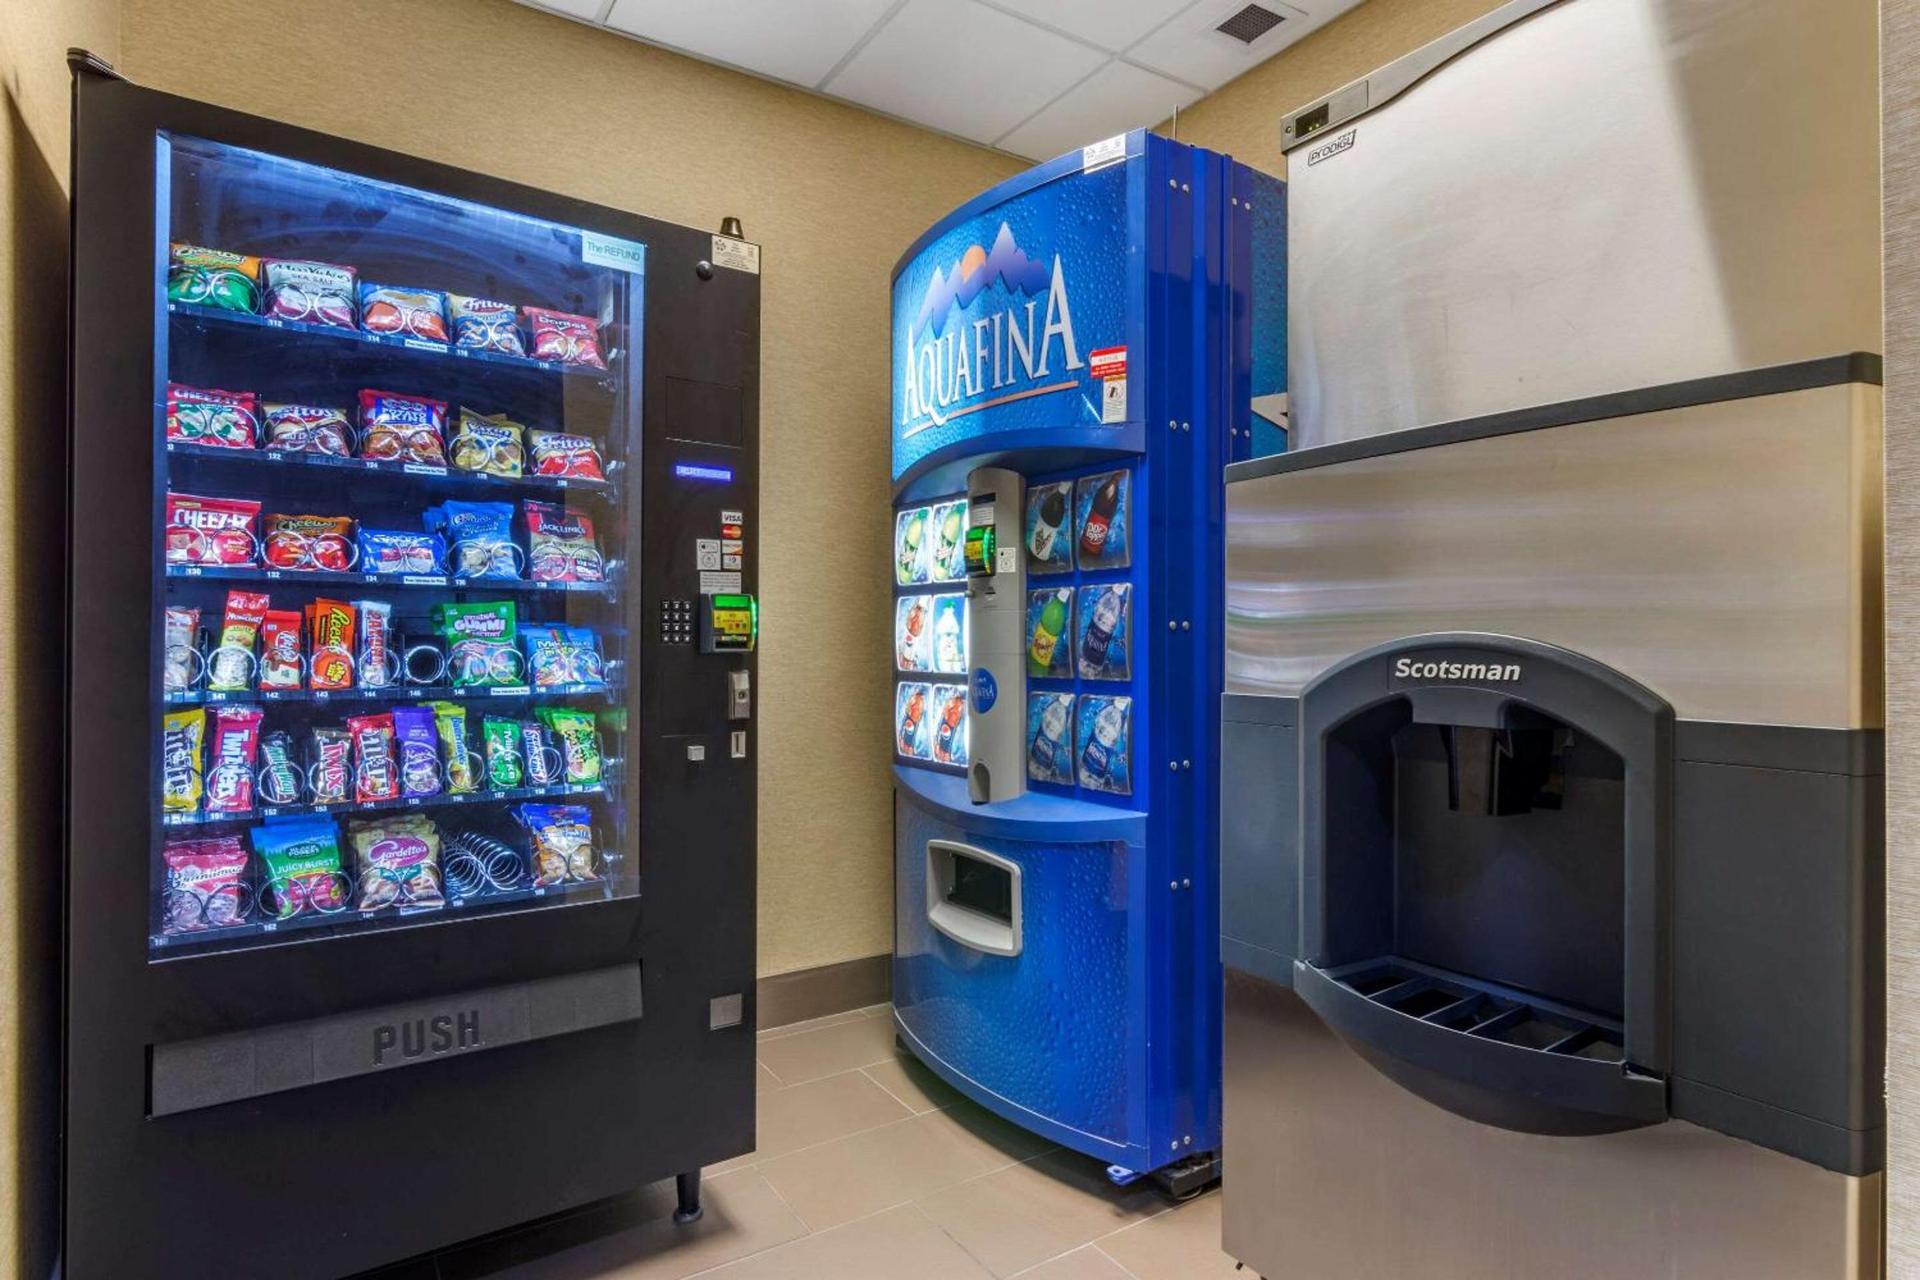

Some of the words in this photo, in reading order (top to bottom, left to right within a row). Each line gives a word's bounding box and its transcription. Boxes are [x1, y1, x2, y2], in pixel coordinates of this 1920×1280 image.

[604, 245, 640, 262] REFUND
[902, 253, 1085, 427] AQUAFINA
[454, 618, 506, 632] GUMMI
[1395, 658, 1521, 681] Scotsman
[264, 808, 277, 816] 152
[368, 840, 427, 863] Gardetto's
[277, 864, 303, 874] JUICY
[305, 858, 334, 869] BURST
[371, 1010, 480, 1066] PUSH
